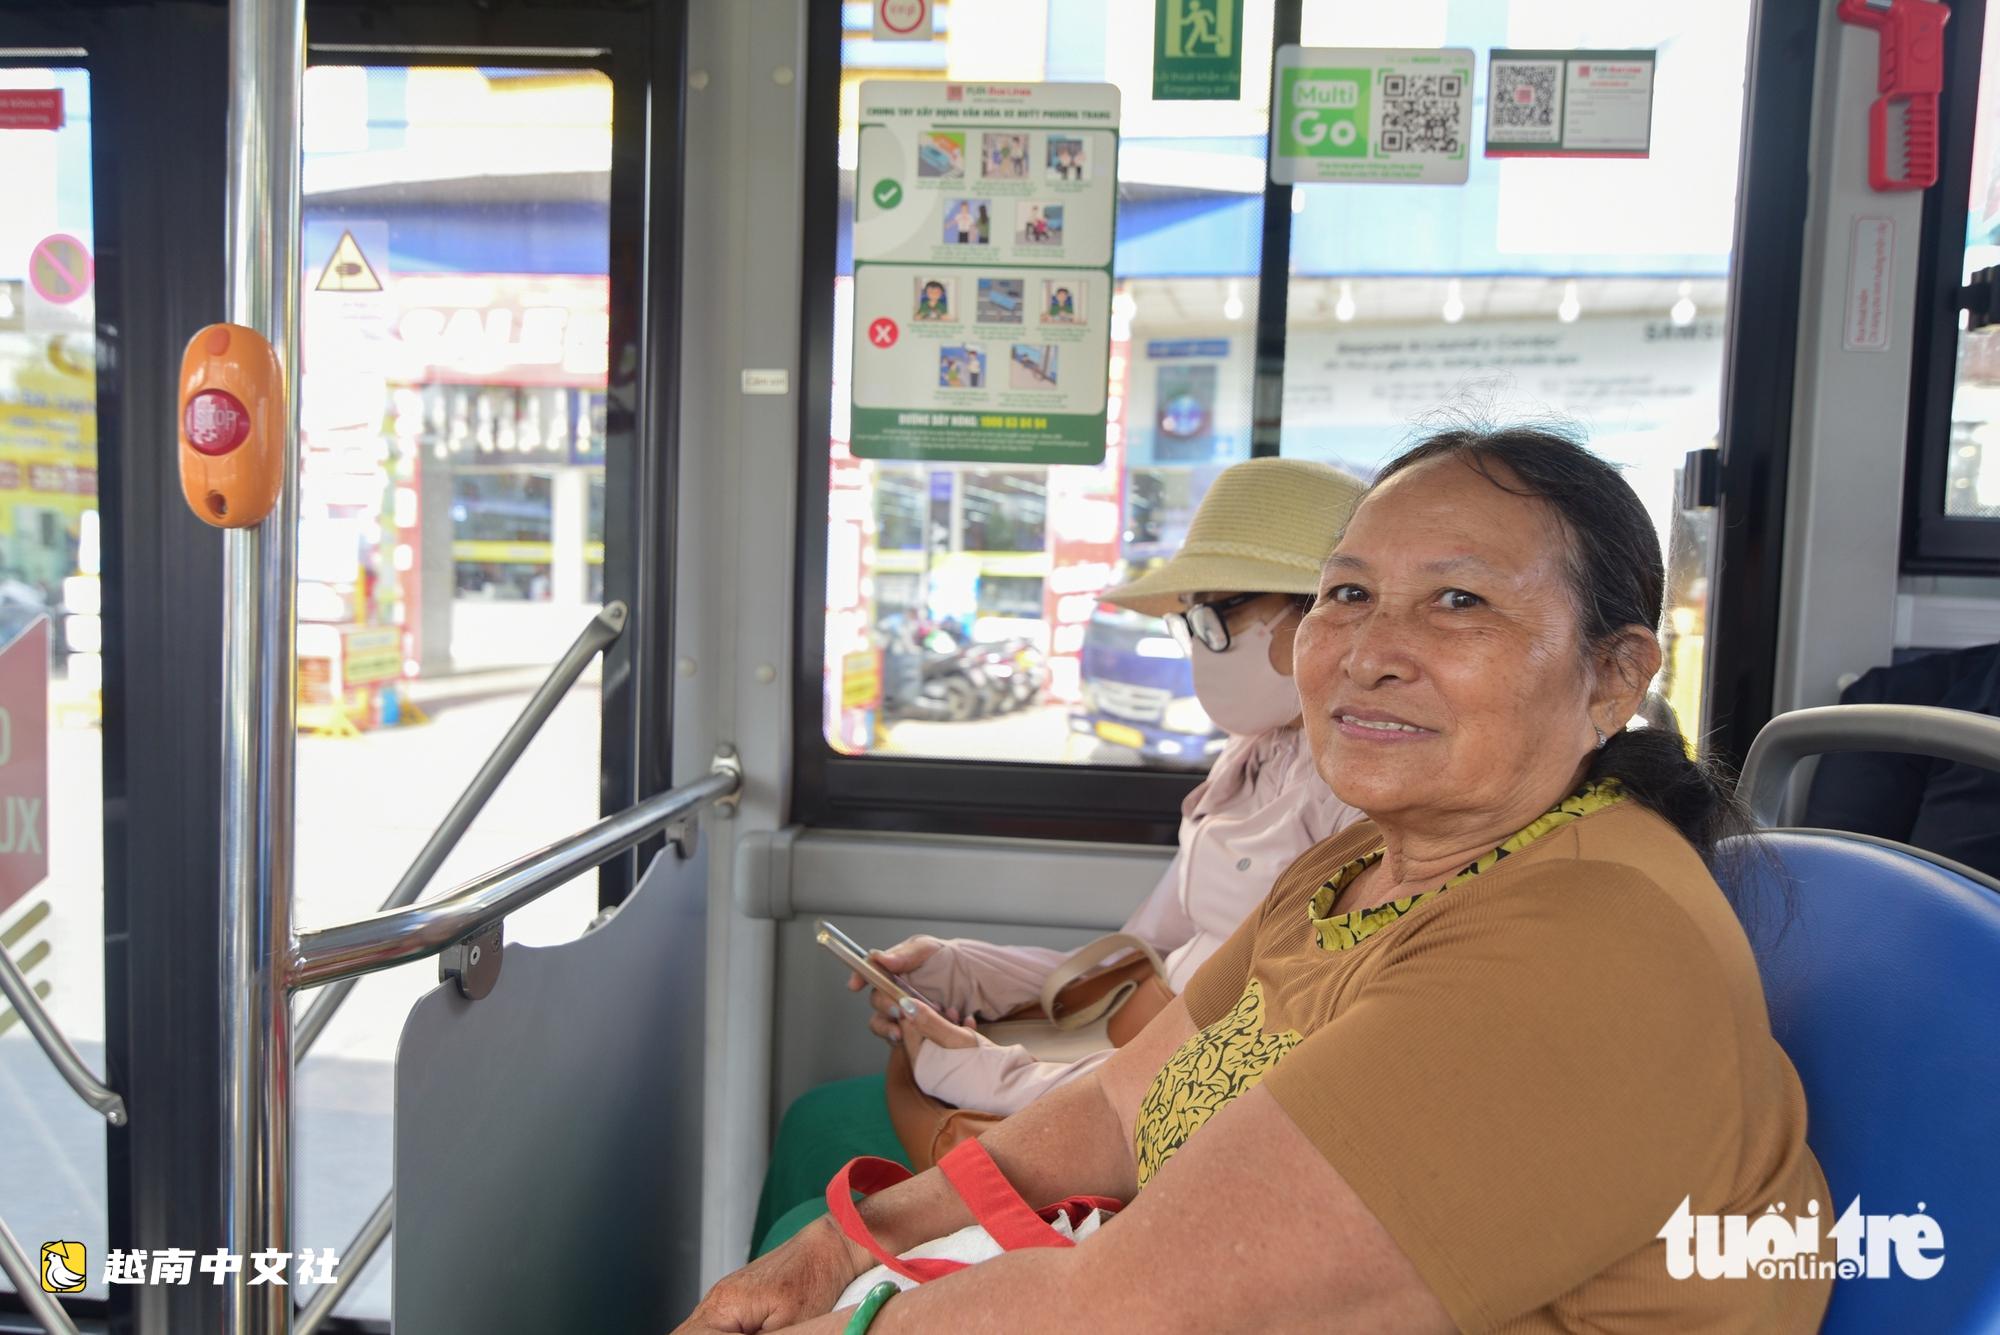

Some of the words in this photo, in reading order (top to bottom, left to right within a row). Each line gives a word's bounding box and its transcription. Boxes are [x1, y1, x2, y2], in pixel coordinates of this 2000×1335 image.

[1299, 84, 1355, 104] Multi
[1291, 111, 1356, 147] Go
[196, 409, 237, 428] STOP
